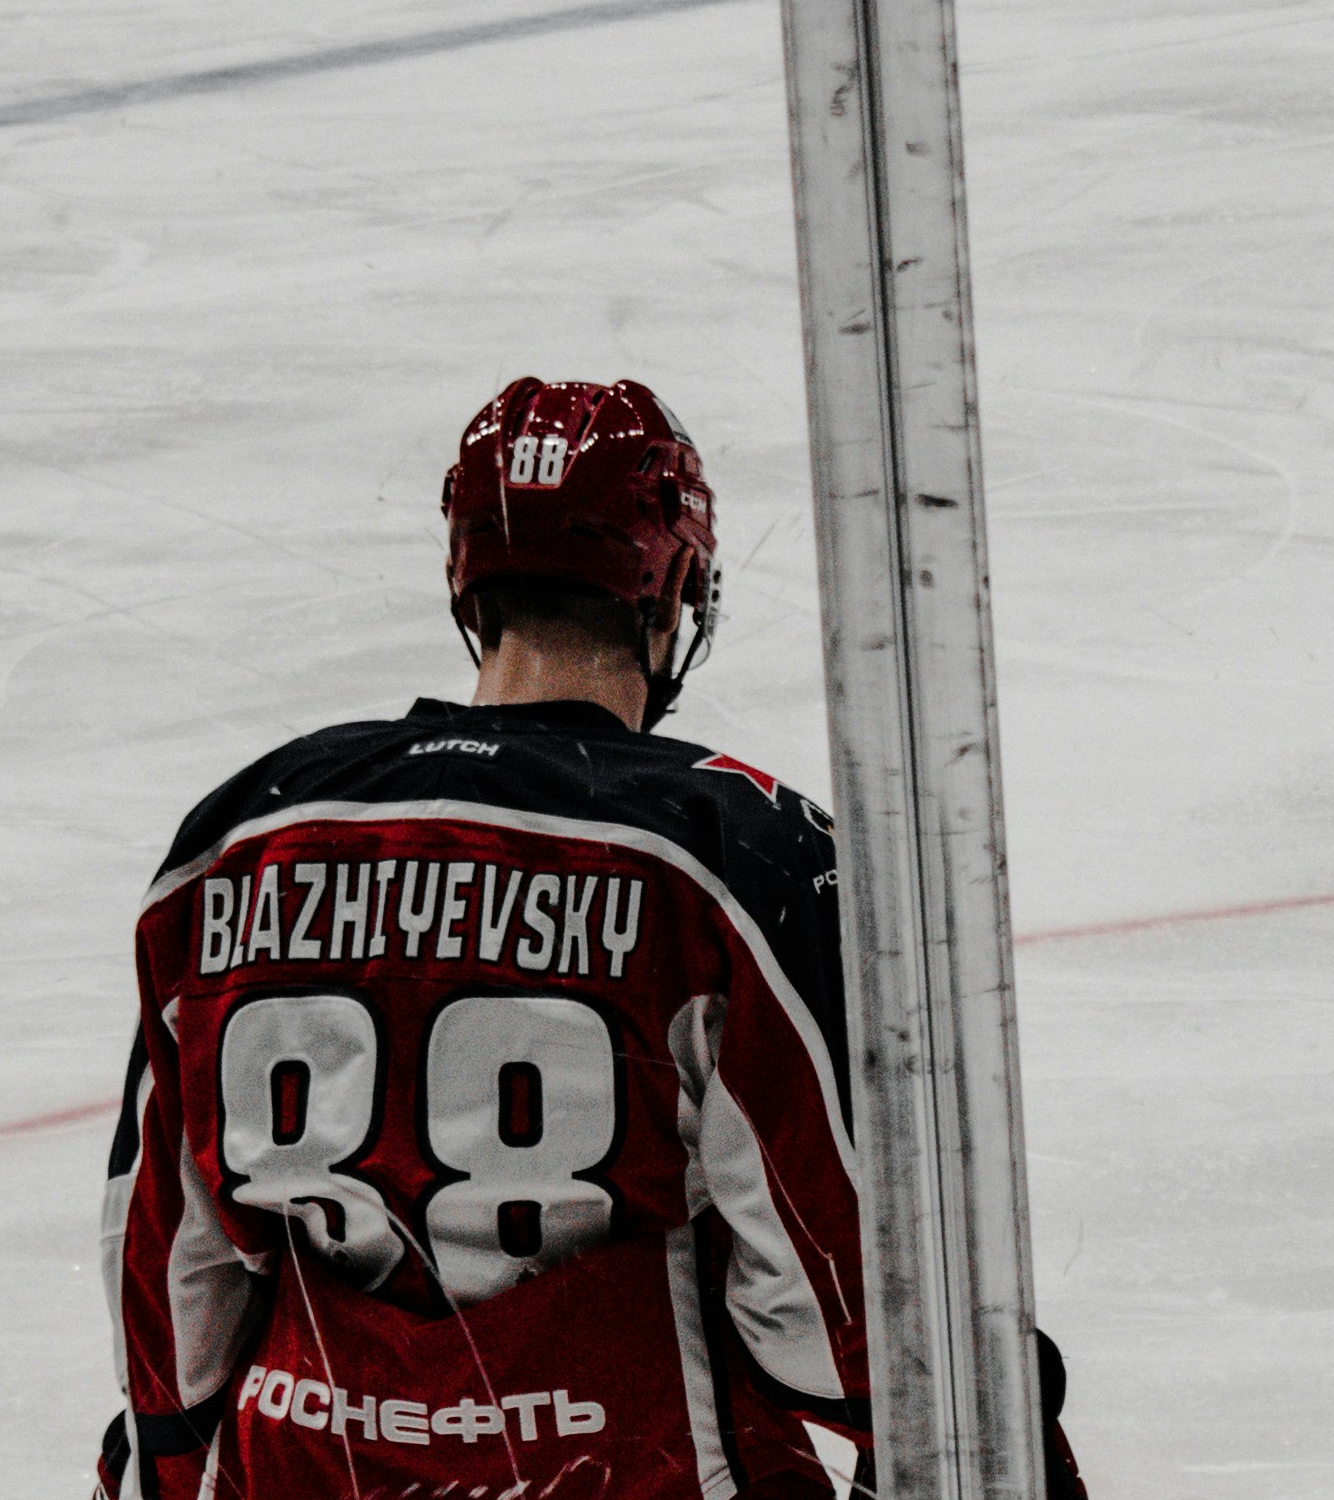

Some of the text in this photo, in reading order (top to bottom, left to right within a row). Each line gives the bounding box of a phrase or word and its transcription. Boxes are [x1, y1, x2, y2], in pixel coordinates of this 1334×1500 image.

[509, 435, 568, 485] 88
[408, 739, 501, 757] LUTCH
[199, 859, 643, 978] BLAZHIYEVSKY
[221, 994, 616, 1302] 88
[237, 1364, 606, 1446] РОСНЕФТЬ
